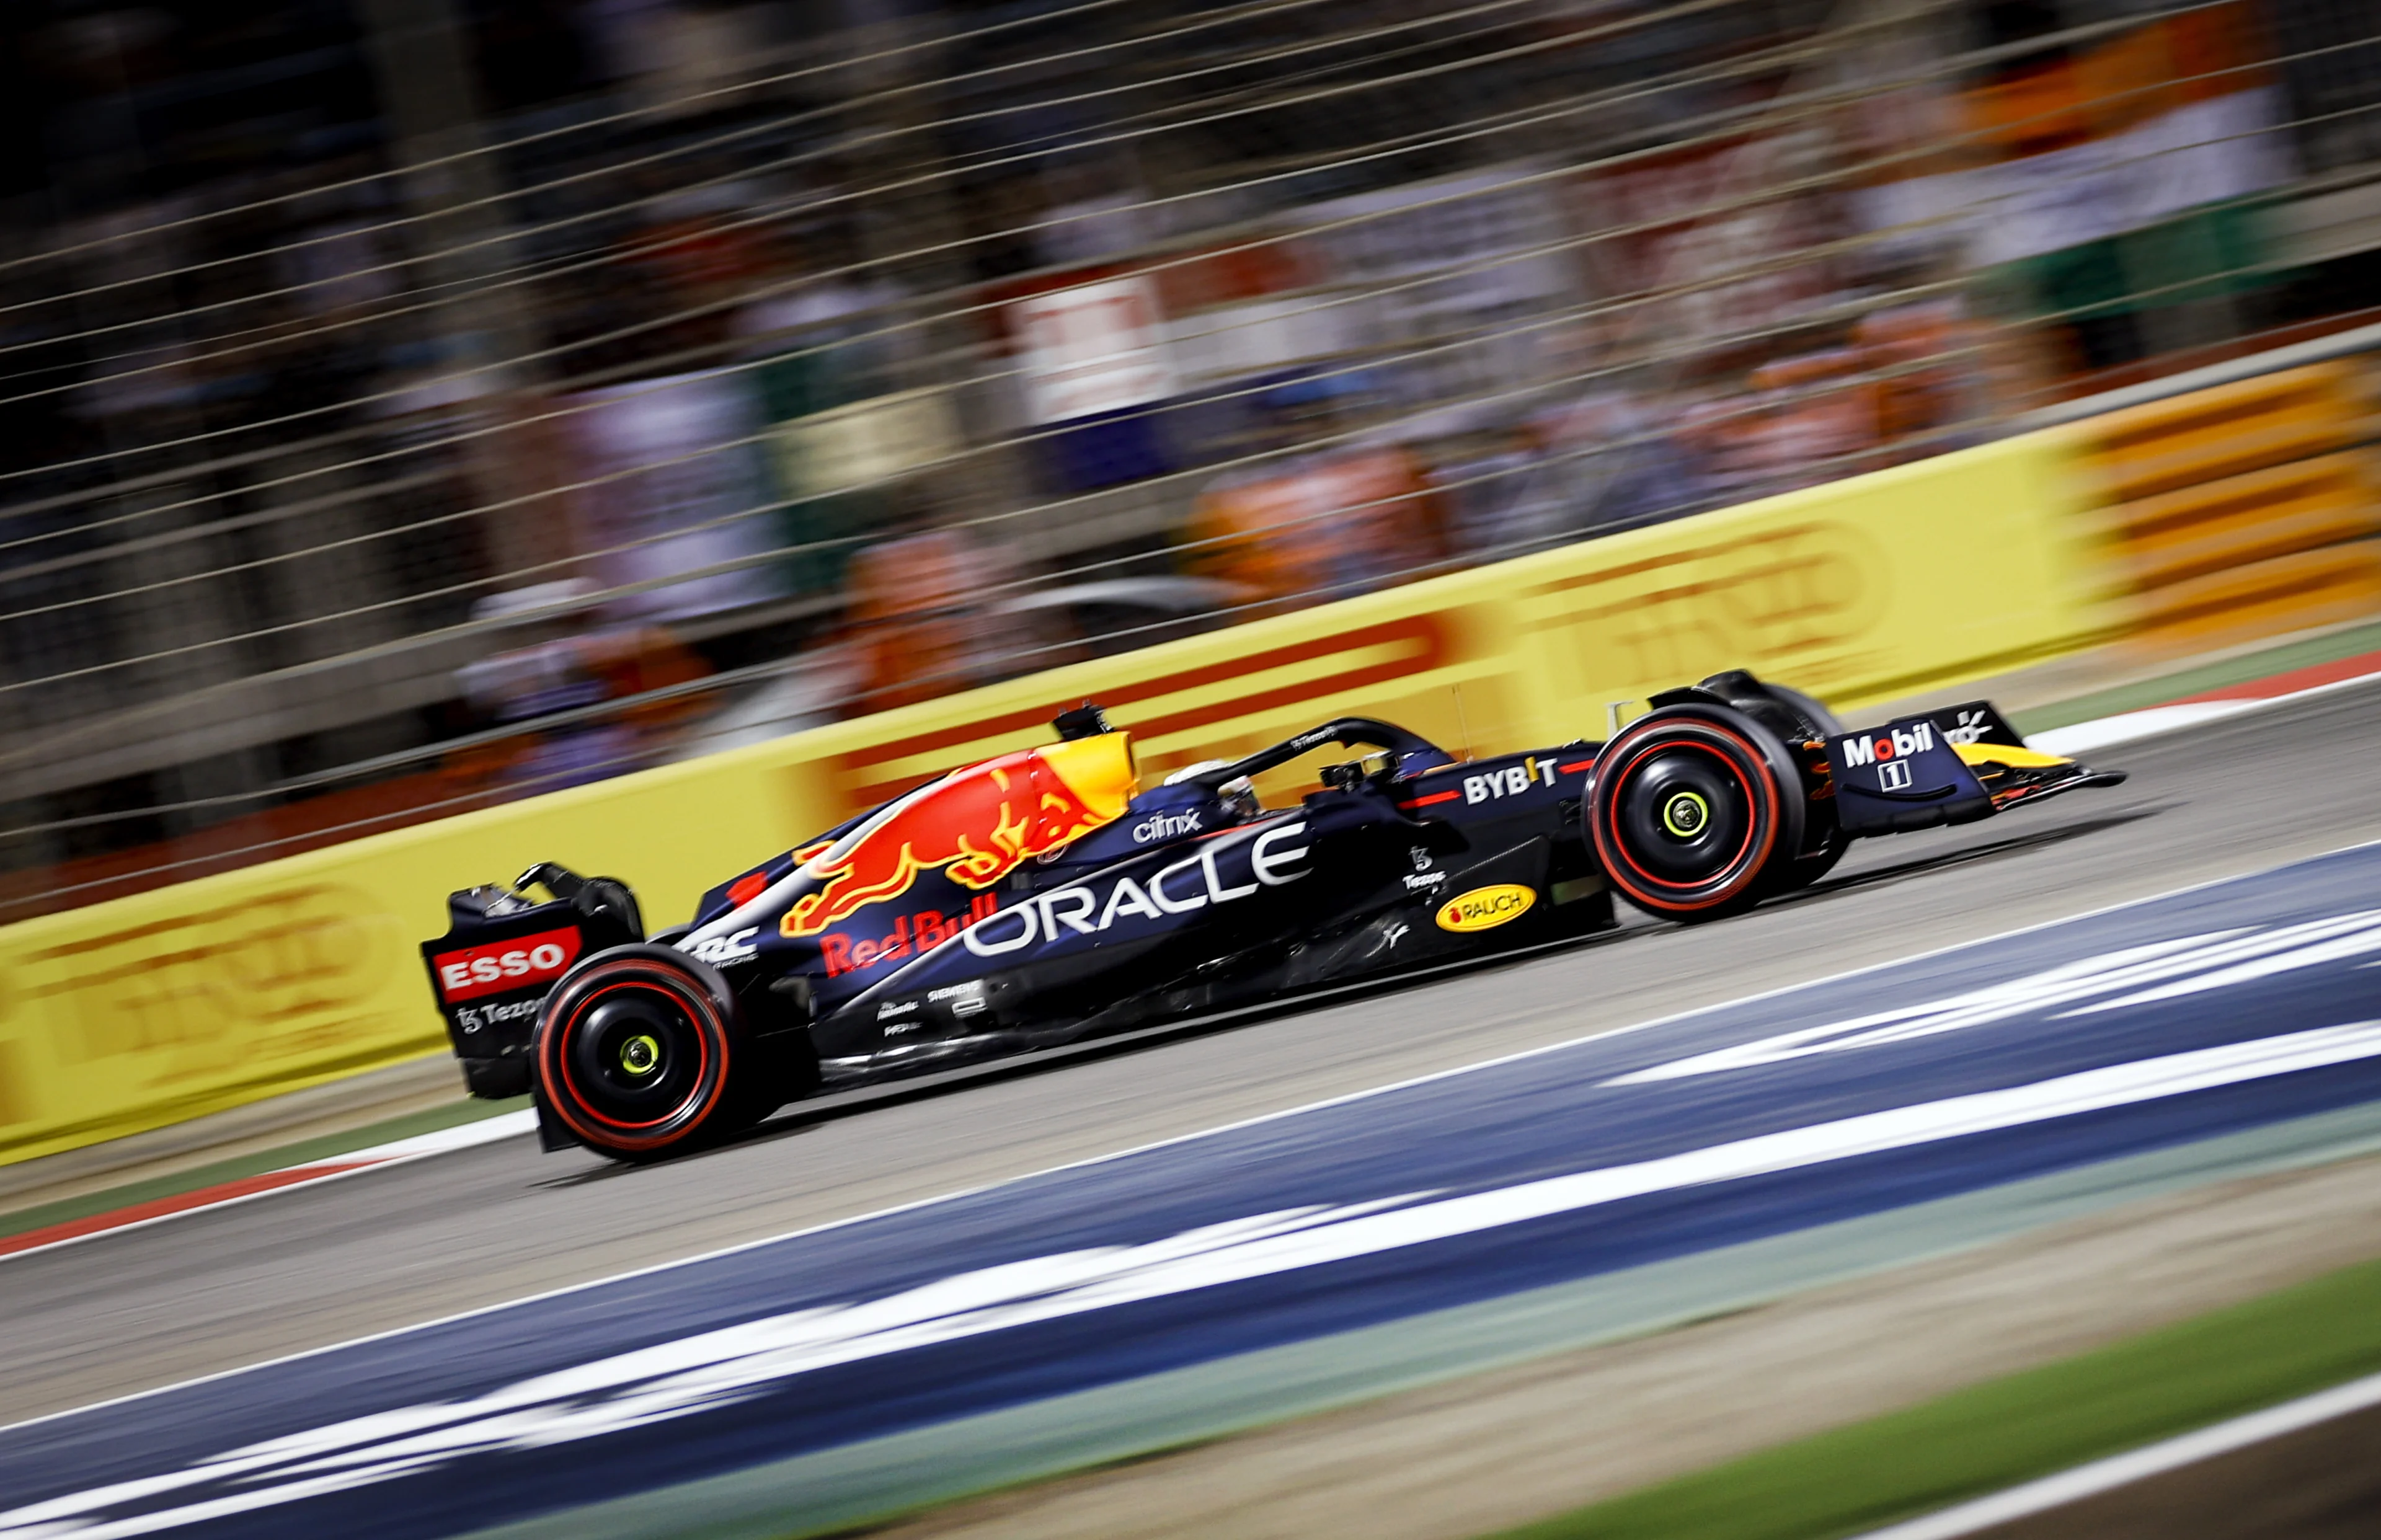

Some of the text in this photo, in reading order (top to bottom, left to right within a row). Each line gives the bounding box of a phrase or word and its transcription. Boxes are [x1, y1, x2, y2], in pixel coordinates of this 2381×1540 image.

[1842, 723, 1933, 767] Mobil
[1463, 756, 1558, 805] BYBIT
[1133, 808, 1202, 843] citrix
[964, 822, 1313, 956] ORACLE
[1462, 893, 1521, 919] RAUCH
[683, 926, 760, 964] RC
[819, 892, 998, 978] Red Bull
[440, 943, 565, 991] ESSO
